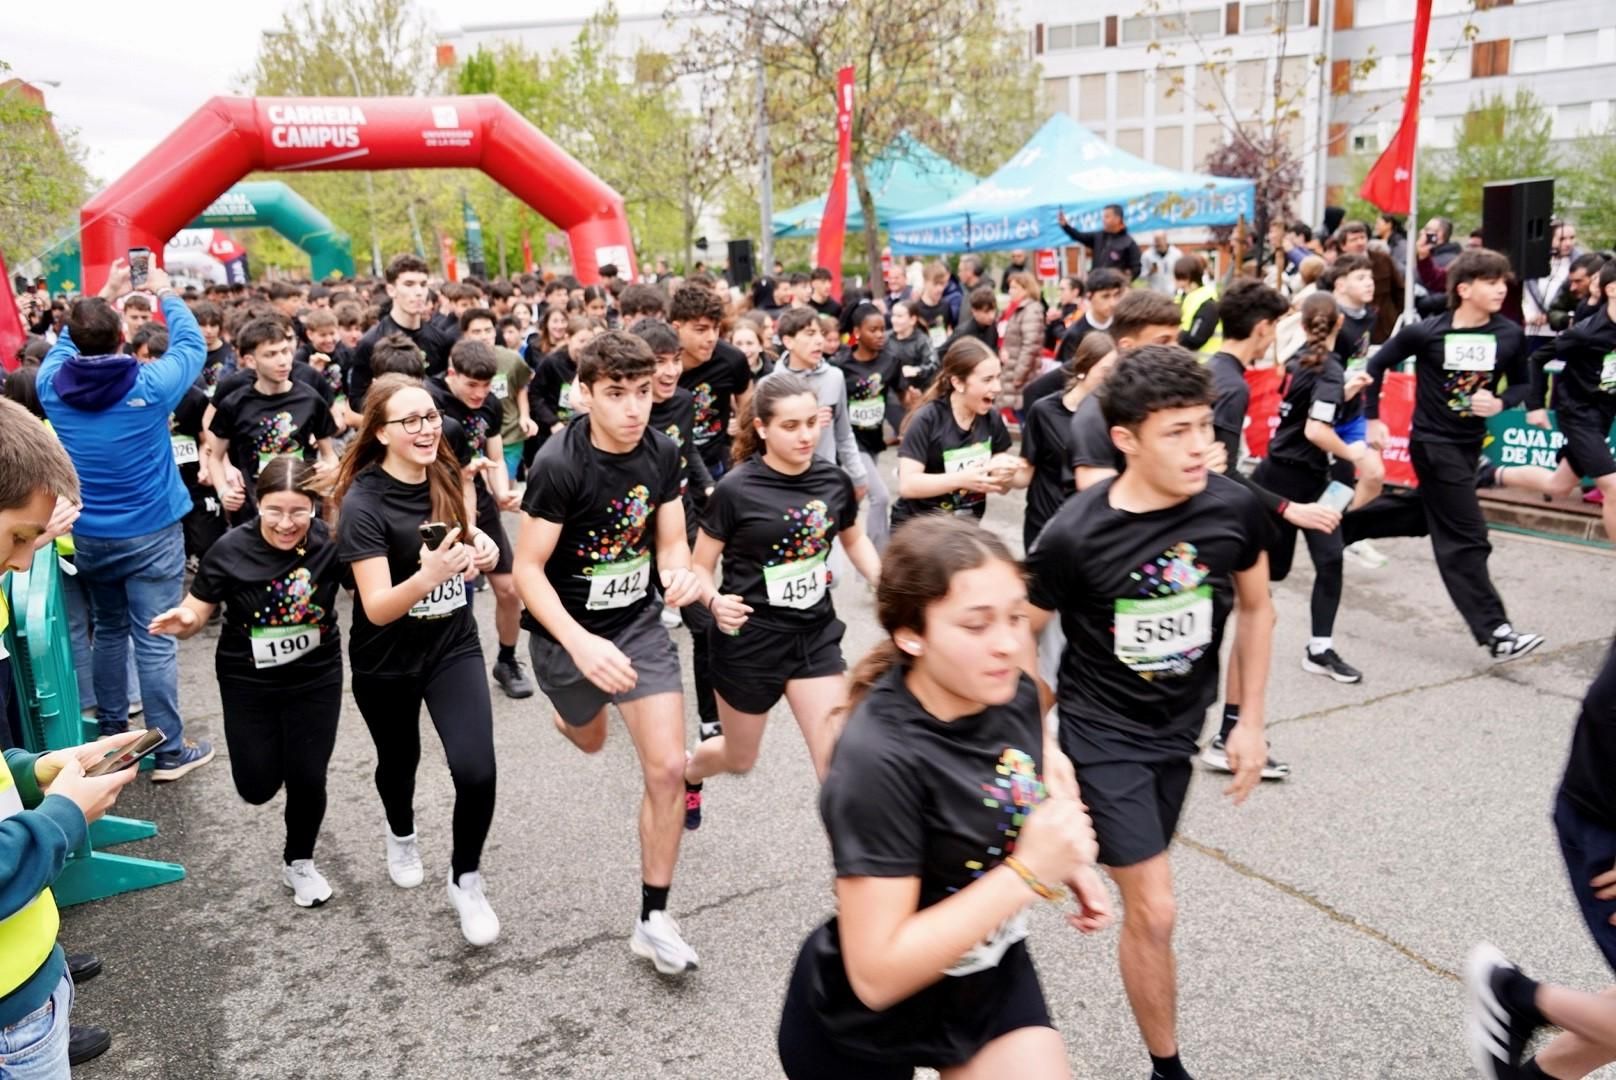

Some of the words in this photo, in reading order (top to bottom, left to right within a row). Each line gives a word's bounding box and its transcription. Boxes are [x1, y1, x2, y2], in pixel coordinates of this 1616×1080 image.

[268, 106, 367, 125] CARRERA
[272, 126, 360, 148] CAMPUS
[1455, 346, 1486, 362] 543
[852, 407, 883, 421] 4038
[1503, 427, 1548, 449] CAJA
[1501, 446, 1528, 464] DE
[602, 571, 641, 598] 442
[782, 571, 818, 602] 454
[1135, 612, 1195, 643] 580
[265, 634, 310, 657] 190
